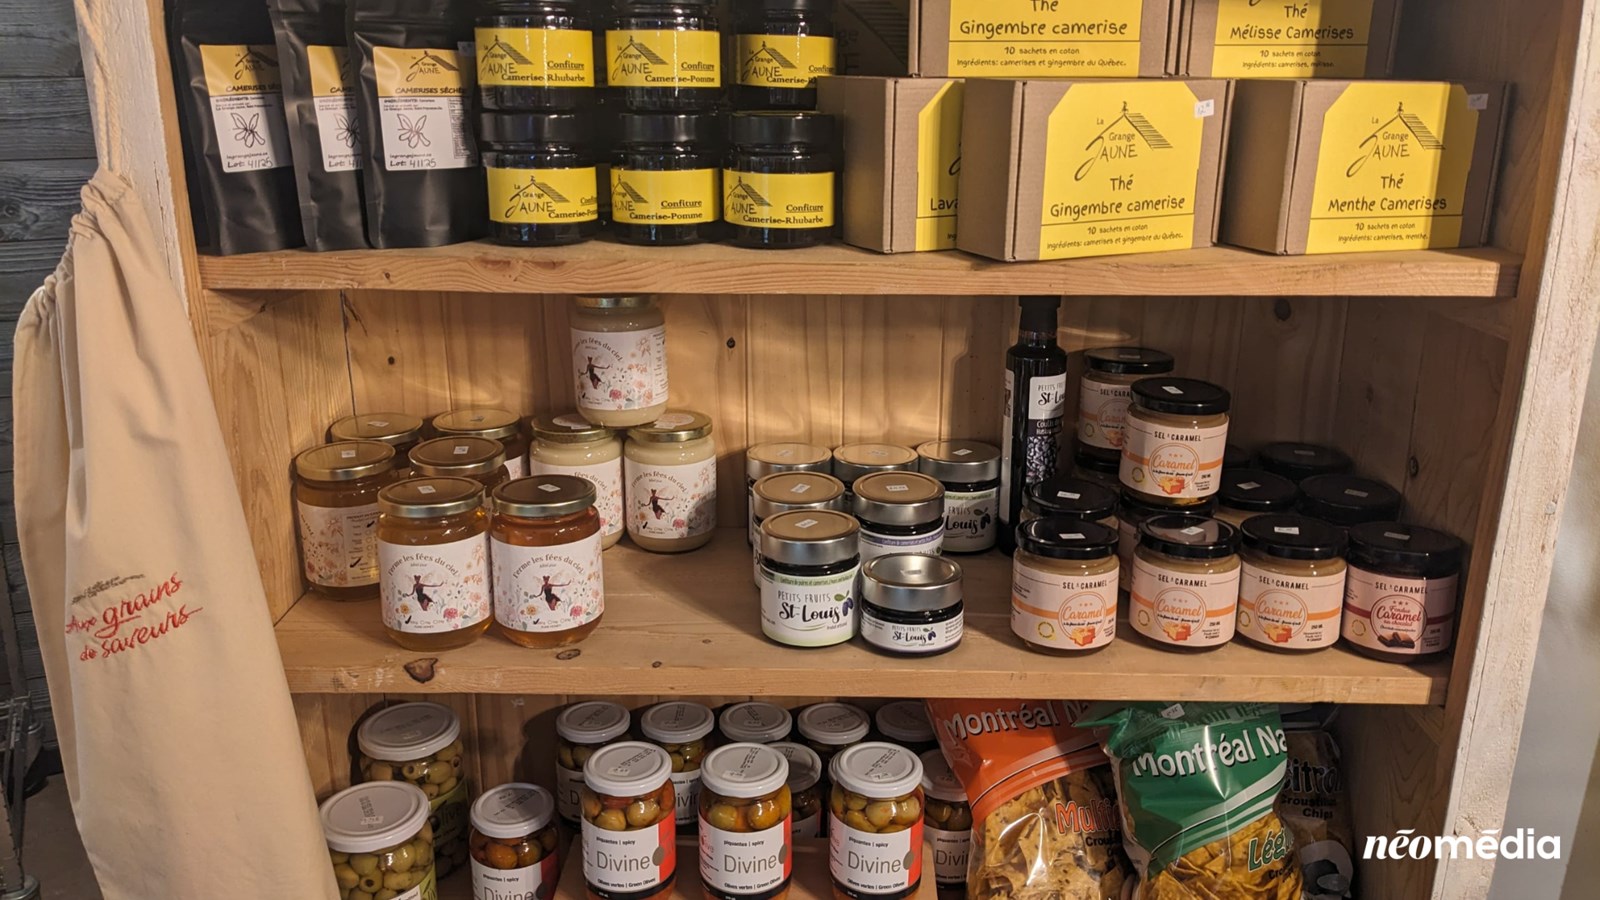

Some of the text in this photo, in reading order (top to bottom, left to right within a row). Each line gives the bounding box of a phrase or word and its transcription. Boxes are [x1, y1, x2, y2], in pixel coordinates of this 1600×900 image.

[1284, 4, 1308, 19] Thé
[960, 20, 1127, 39] Gingembre camerise
[1230, 24, 1354, 40] Mélisse Camerises
[1004, 46, 1015, 55] 10
[1019, 47, 1047, 55] sachets
[1059, 47, 1080, 55] coton
[1260, 50, 1270, 58] 10
[1272, 50, 1295, 58] sachets
[547, 60, 585, 69] Confiture
[681, 62, 715, 70] Confiture
[957, 58, 998, 68] Ingrédients:
[1047, 59, 1085, 68] gingembre
[501, 73, 585, 82] Camerise-Rhubarbe
[645, 74, 715, 83] Camerise-Pomme
[1097, 117, 1104, 125] La
[1371, 116, 1379, 125] La
[1109, 132, 1136, 142] Grange
[1382, 131, 1409, 141] Grange
[247, 158, 273, 169] 41125
[409, 158, 437, 168] 41125
[1110, 174, 1134, 192] Thé
[1381, 173, 1405, 189] Thé
[522, 191, 545, 199] Grange
[661, 200, 702, 208] Confiture
[786, 204, 824, 212] Confiture
[1050, 195, 1185, 221] Gingembre camerise
[1328, 196, 1447, 212] Menthe Camerises
[629, 212, 703, 221] Camerise-Pomme
[743, 215, 824, 225] Camerise-Rhubarbe
[1087, 227, 1097, 235] 10
[1099, 225, 1122, 234] sachets
[1355, 222, 1365, 231] 10
[1367, 222, 1389, 230] sachets
[1083, 238, 1113, 246] camerises
[1122, 235, 1152, 245] gingembre
[588, 337, 602, 346] fées
[1100, 388, 1111, 396] SEL
[1154, 431, 1201, 442] SEL CARAMEL
[1153, 454, 1195, 470] Caramel
[653, 470, 668, 479] fées
[668, 475, 677, 483] du
[415, 553, 434, 562] fées
[434, 557, 446, 567] du
[445, 562, 459, 576] ciel
[512, 559, 531, 579] Ferme
[531, 556, 544, 564] les
[545, 553, 563, 562] fées
[563, 557, 574, 565] du
[573, 562, 584, 574] ciel
[1062, 580, 1108, 590] SEL CARAMEL
[1157, 573, 1208, 588] SEL CARAMEL
[1259, 575, 1310, 590] SEL CARAMEL
[1375, 582, 1428, 594] SEL CARAMEL
[777, 590, 831, 603] PETITS FRUITS
[94, 571, 183, 639] grains
[1157, 598, 1202, 617] Caramel
[1258, 599, 1303, 619] Caramel
[778, 601, 841, 624] St-Louis
[1062, 606, 1103, 621] Caramel
[1376, 605, 1422, 623] Caramel
[80, 604, 203, 661] de saveurs
[892, 631, 927, 643] St-Louis
[944, 703, 1061, 746] Montréal
[1132, 730, 1257, 778] Montréal
[596, 850, 651, 872] Divine
[724, 854, 777, 874] Divine
[847, 850, 901, 874] Divine
[483, 887, 534, 900] Divine
